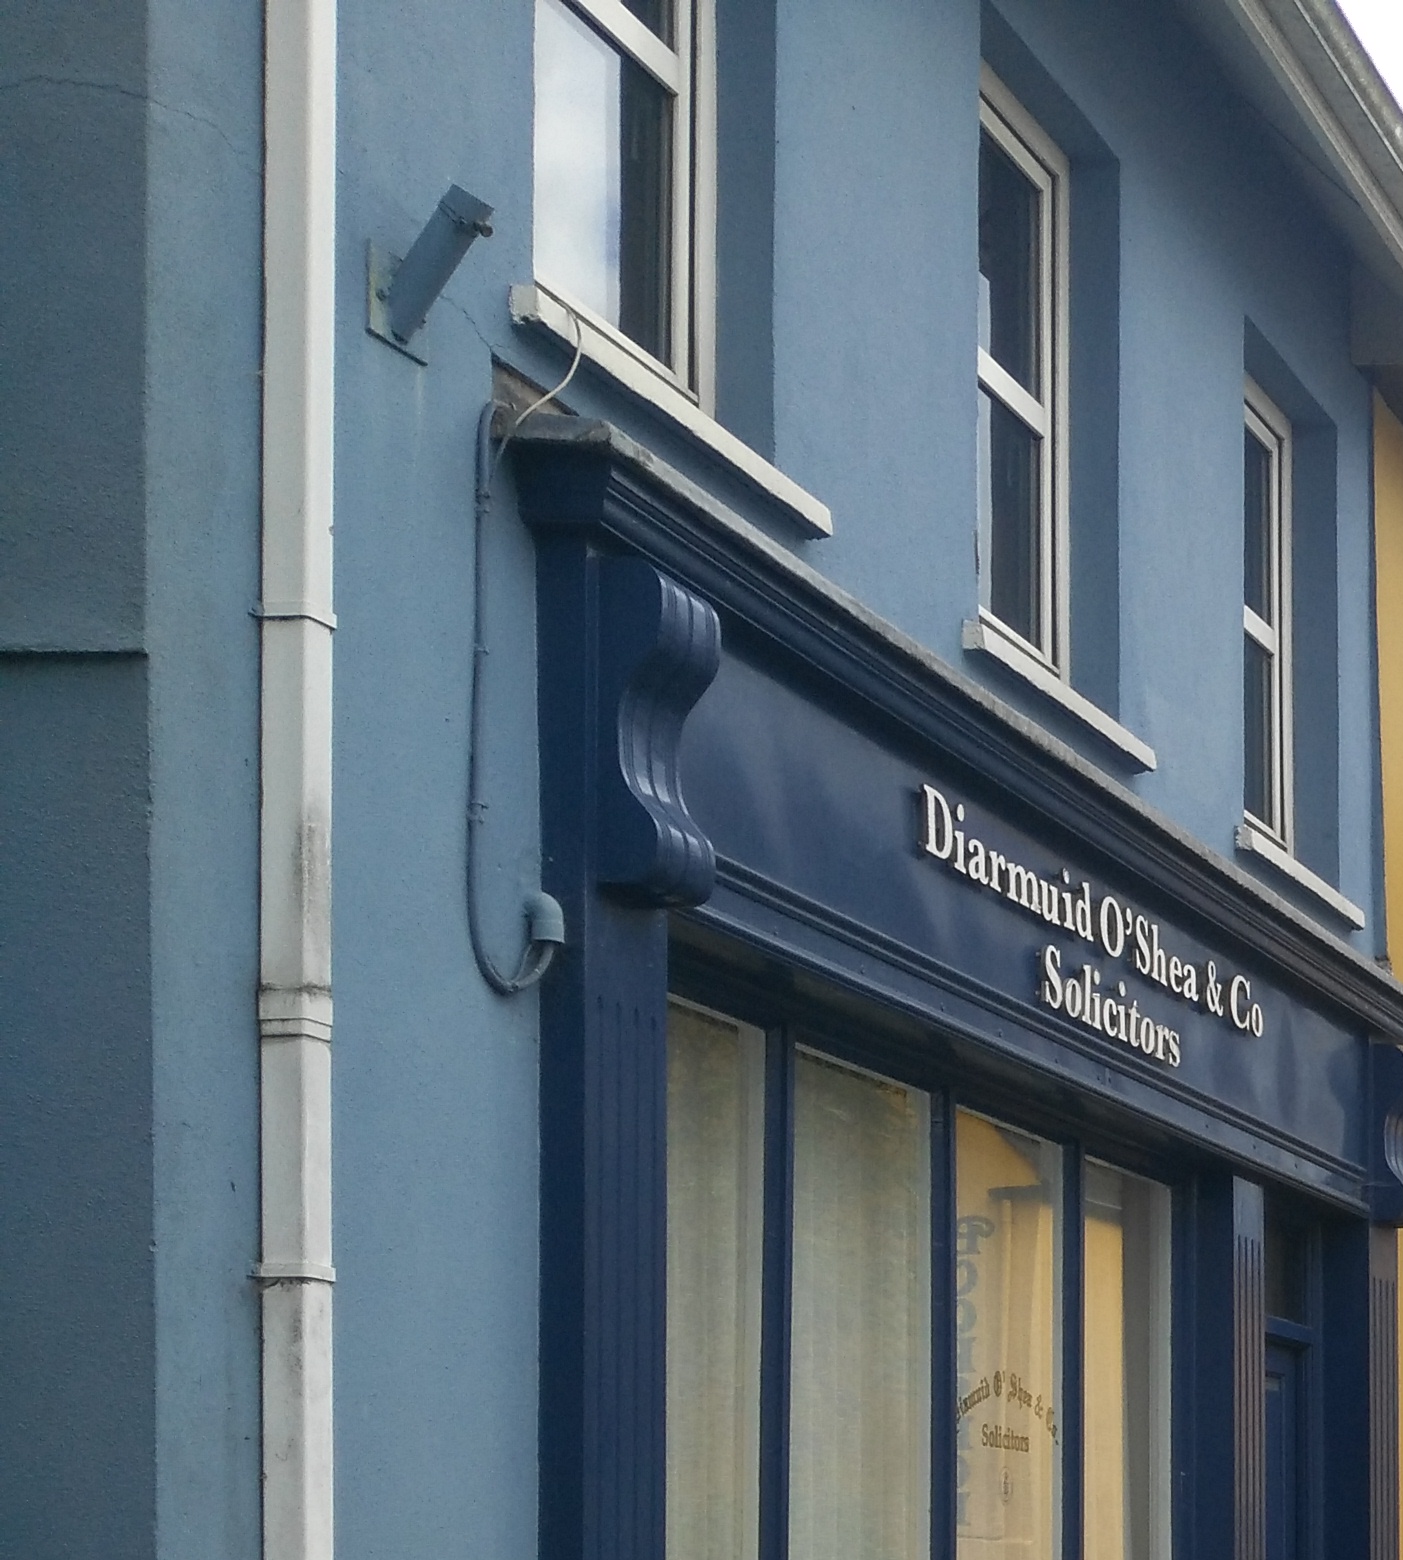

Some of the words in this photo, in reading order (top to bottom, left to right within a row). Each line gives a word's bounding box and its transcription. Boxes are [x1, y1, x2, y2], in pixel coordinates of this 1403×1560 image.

[920, 783, 1094, 943] Diarmuid
[1099, 895, 1201, 1002] O'Shea
[1205, 960, 1225, 1018] &
[1229, 974, 1264, 1039] Co
[1042, 943, 1182, 1068] Solicitors
[981, 1423, 1029, 1453] Solicitors
[1034, 1394, 1044, 1420] &
